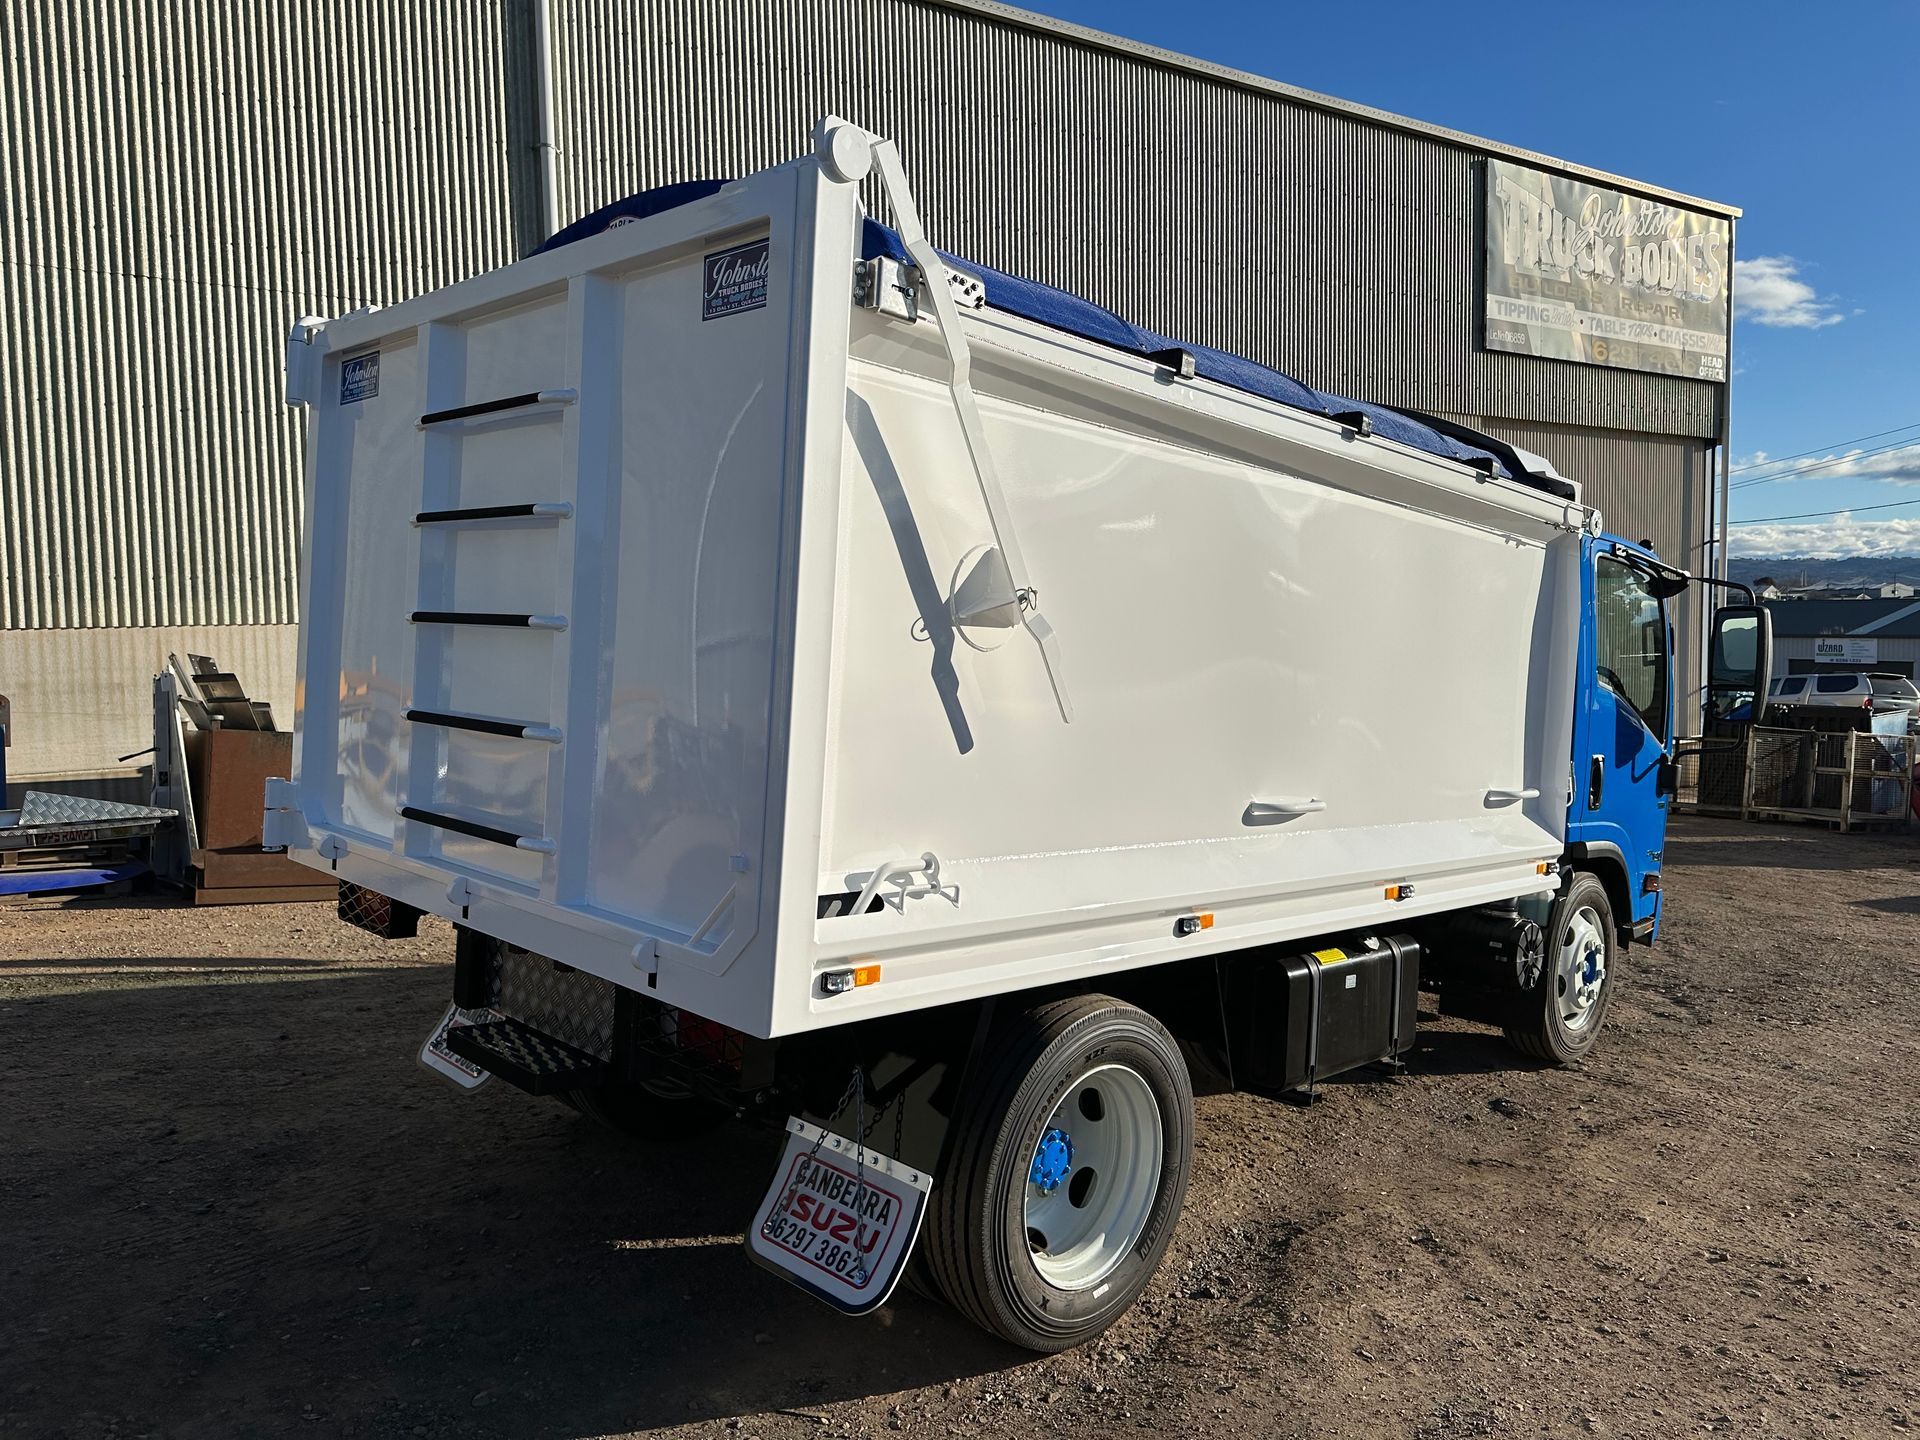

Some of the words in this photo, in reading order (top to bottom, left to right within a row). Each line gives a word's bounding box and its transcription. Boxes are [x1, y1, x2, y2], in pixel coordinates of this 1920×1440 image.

[1495, 175, 1616, 281] TRUCK
[1620, 231, 1722, 303] BODIES
[1571, 193, 1678, 256] Johnston
[718, 285, 740, 297] TRUCK
[740, 279, 763, 292] BODIES
[1494, 300, 1550, 324] TIPPING
[1587, 316, 1626, 335] TABLE
[1658, 331, 1706, 347] CHASSIS
[1698, 366, 1724, 380] OFFICE
[1701, 355, 1723, 369] HEAD
[796, 1159, 892, 1226] CANBERRA
[782, 1188, 881, 1254] ISUZU
[814, 1239, 859, 1281] 3862
